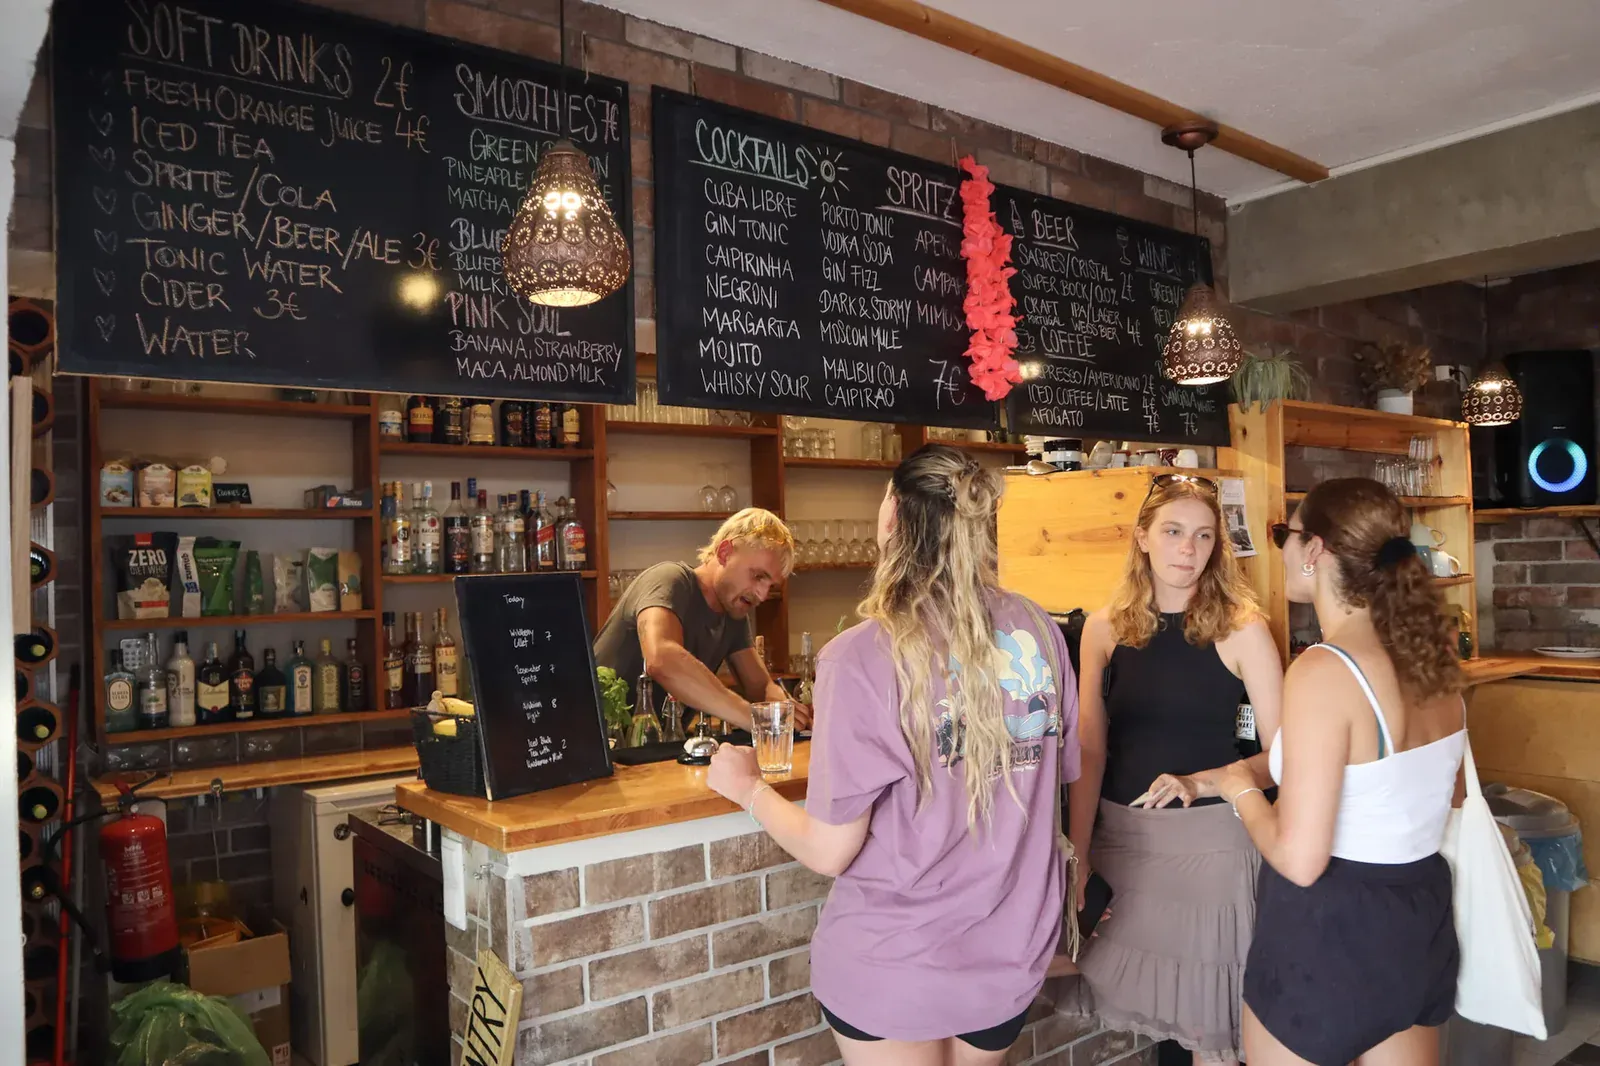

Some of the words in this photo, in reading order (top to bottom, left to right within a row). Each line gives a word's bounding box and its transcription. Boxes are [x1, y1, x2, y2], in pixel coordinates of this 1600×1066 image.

[126, 1, 223, 67] SOFT
[231, 23, 353, 97] DRINKS
[373, 56, 414, 111] 2€
[453, 63, 597, 142] SMOOTHIES
[598, 99, 620, 145] 7€
[130, 105, 198, 151] ICED
[204, 121, 275, 164] TEA
[320, 107, 384, 147] JUICE
[395, 112, 431, 154] 4€
[469, 128, 538, 164] GREEN
[695, 118, 809, 187] COCKTAILS
[704, 177, 748, 209] CUBA
[751, 186, 798, 219] LIBRE
[886, 165, 957, 219] SPRITZ
[705, 210, 736, 236] GIN
[738, 219, 789, 245] TONIC
[821, 201, 859, 231] PORTO
[860, 211, 894, 239] TONIC
[1031, 208, 1080, 250] BEER
[406, 231, 442, 272] 3€
[705, 243, 794, 281] CAIPIRINHA
[820, 228, 860, 258] VODKA
[862, 233, 894, 266] SODA
[1136, 238, 1174, 273] WINE
[125, 237, 228, 276] TONIC
[243, 247, 343, 294] WATER
[822, 256, 846, 283] GIN
[850, 265, 883, 292] FIZZ
[140, 271, 231, 312] CIDER
[252, 288, 307, 321] 3€
[706, 272, 778, 309] NEGRONI
[1021, 268, 1060, 295] SUPER
[1120, 271, 1136, 302] 2€
[444, 291, 510, 330] PINK
[516, 296, 573, 337] SOUL
[818, 289, 857, 316] DARK
[859, 296, 871, 319] &
[871, 296, 912, 330] STORMY
[1023, 295, 1059, 316] CRAFT
[1127, 316, 1143, 347] 4€
[1026, 313, 1065, 327] PORTUGAL
[135, 312, 257, 359] WATER
[699, 336, 762, 367] MOJITO
[819, 319, 868, 348] MOSCOW
[871, 326, 903, 352] MULE
[1040, 326, 1096, 358] COFFEE
[534, 337, 622, 372] STRAWBERRY
[822, 355, 875, 385] MALIBU
[876, 361, 909, 389] COLA
[513, 362, 569, 383] ALMOND
[570, 363, 606, 386] MILK
[700, 368, 766, 399] WHISKY
[770, 369, 812, 401] SOUR
[929, 358, 966, 410] 7€
[1036, 363, 1140, 391] PRESSO/AMERICANO
[1142, 374, 1157, 397] 2€
[1027, 383, 1053, 405] ICED
[1142, 396, 1158, 415] 4€
[1030, 406, 1084, 427] AFOGATO
[1143, 414, 1161, 435] 7€
[1179, 411, 1198, 436] 7€
[128, 549, 167, 567] ZERO
[502, 593, 525, 609] Today
[551, 698, 557, 708] 8
[561, 738, 567, 749] 2
